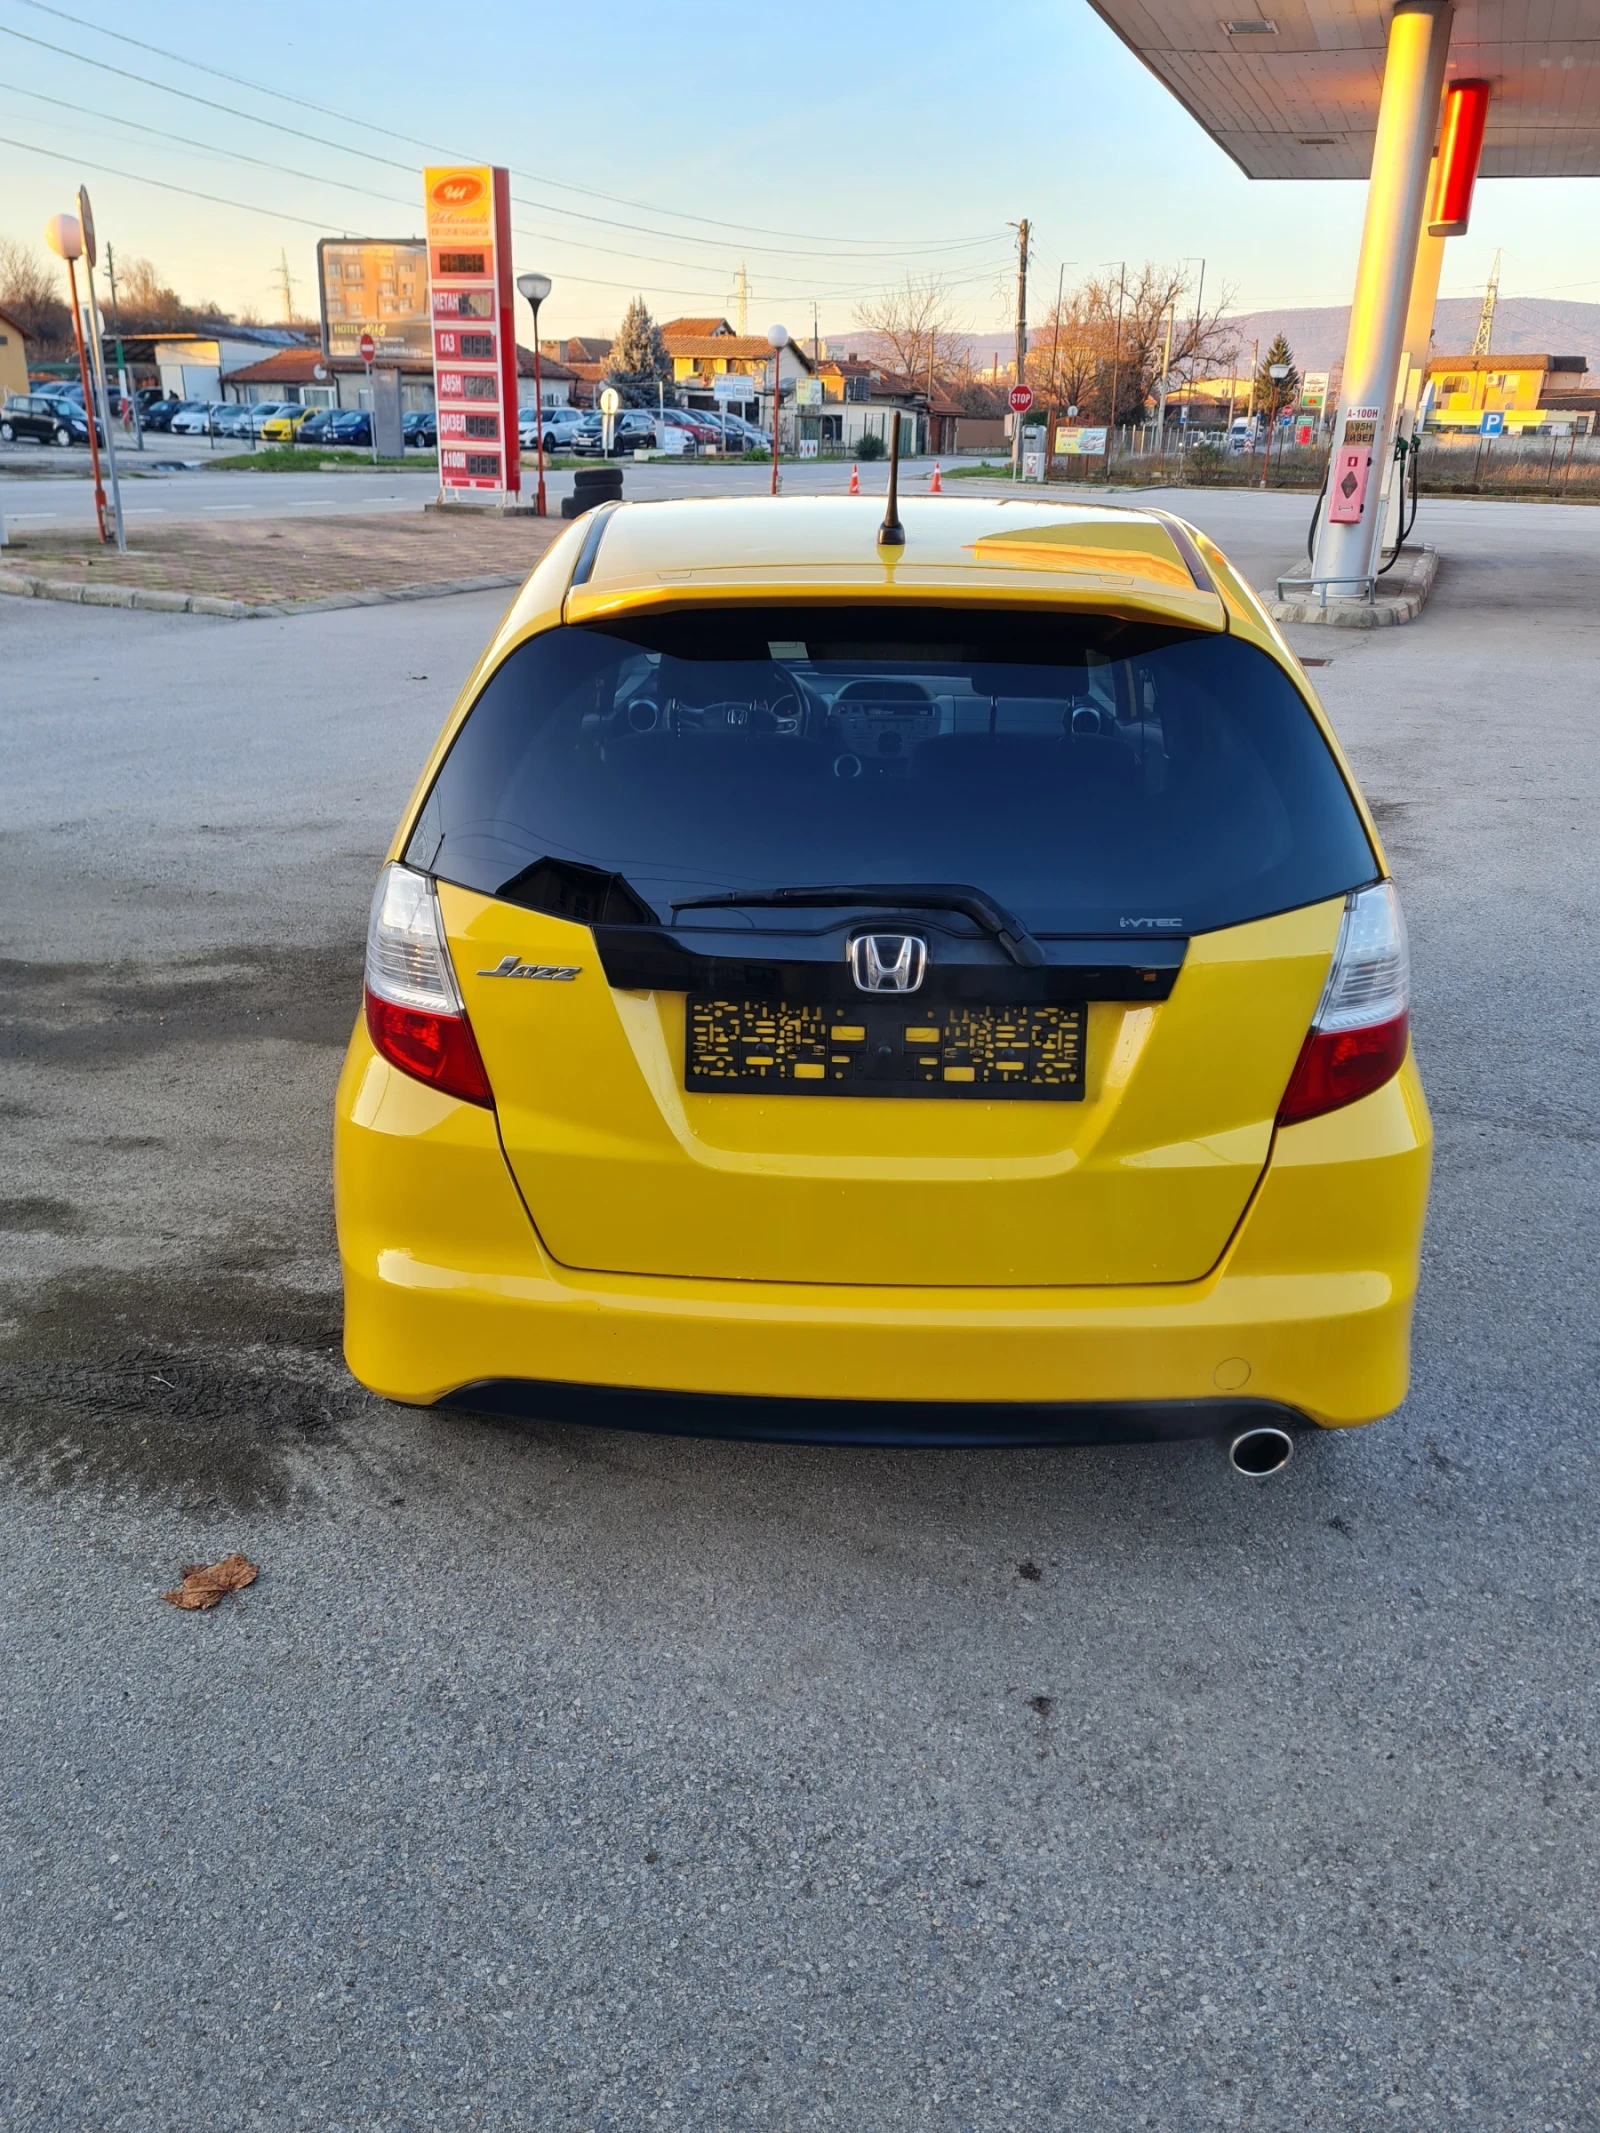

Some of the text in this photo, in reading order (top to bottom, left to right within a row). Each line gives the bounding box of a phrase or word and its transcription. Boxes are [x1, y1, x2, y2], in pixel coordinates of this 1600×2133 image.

[433, 292, 459, 310] МЕТАН
[333, 324, 359, 334] HOTEL
[440, 333, 455, 352] ГАЗ
[1011, 393, 1031, 404] STOP
[440, 414, 467, 434] ДИЗЕЛ
[1486, 414, 1500, 431] P
